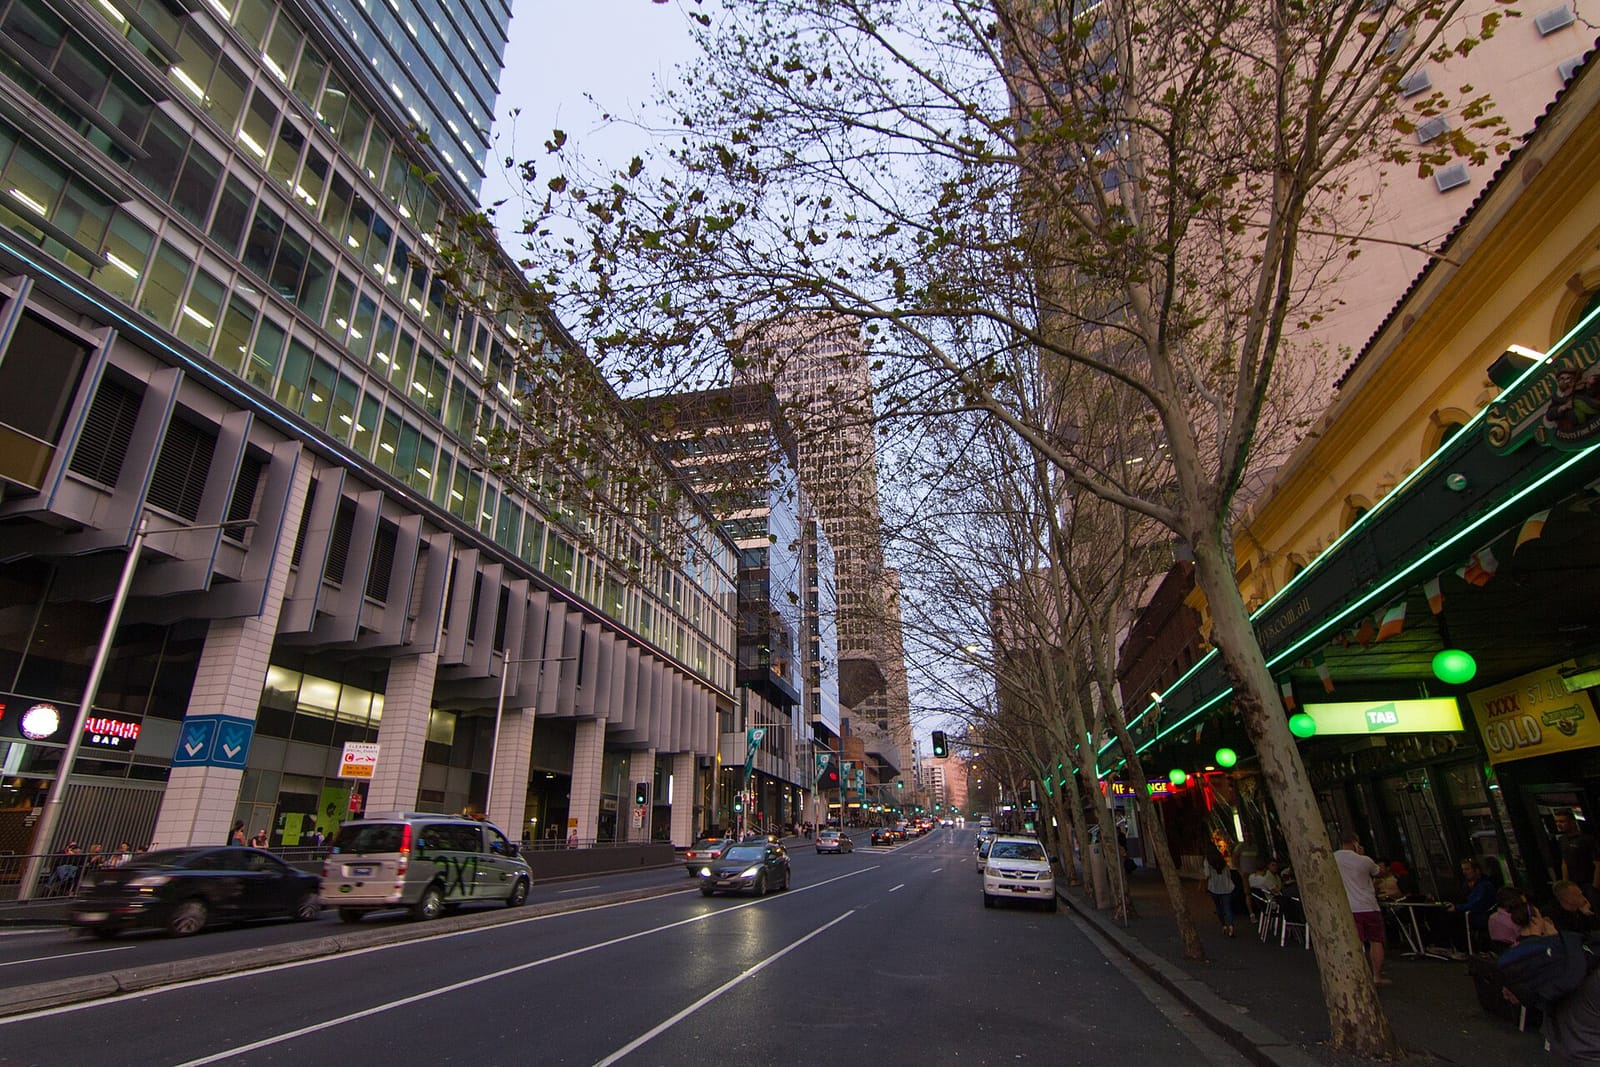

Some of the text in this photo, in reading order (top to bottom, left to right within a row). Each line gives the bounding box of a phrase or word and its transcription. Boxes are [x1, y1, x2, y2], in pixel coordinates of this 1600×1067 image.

[1485, 694, 1520, 718] XXXX
[1366, 711, 1397, 724] TAB
[92, 734, 120, 746] BAR
[1484, 715, 1542, 752] GOLD
